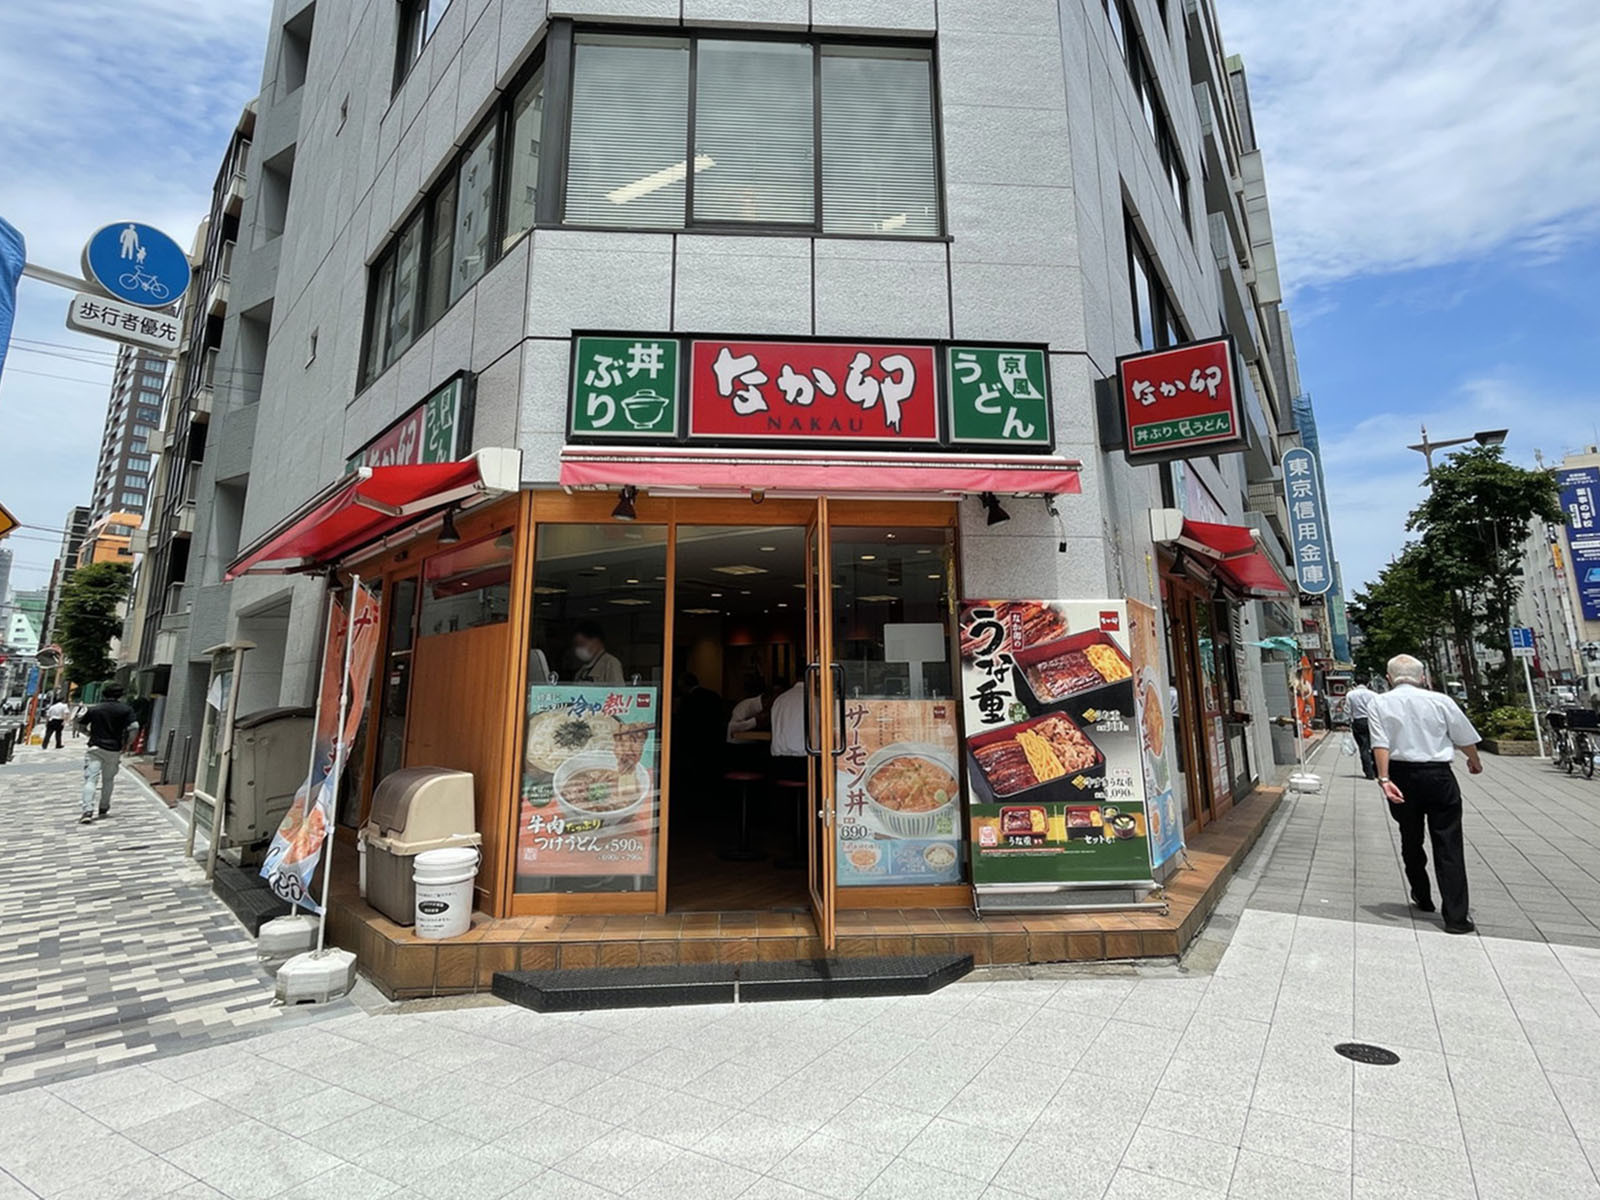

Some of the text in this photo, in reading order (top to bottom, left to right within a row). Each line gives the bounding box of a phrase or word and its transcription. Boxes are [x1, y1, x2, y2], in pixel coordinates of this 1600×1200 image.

[79, 301, 178, 342] 歩行者優先
[712, 346, 917, 435] なか卯
[955, 353, 1035, 439] うどん
[1131, 365, 1223, 406] なか卯
[767, 415, 863, 432] NAKAU
[1288, 458, 1325, 584] 東京信用金庫
[969, 609, 1014, 724] うな重
[844, 703, 869, 817] サーモン丼
[527, 814, 566, 835] 牛肉
[533, 836, 602, 852] つけうどん
